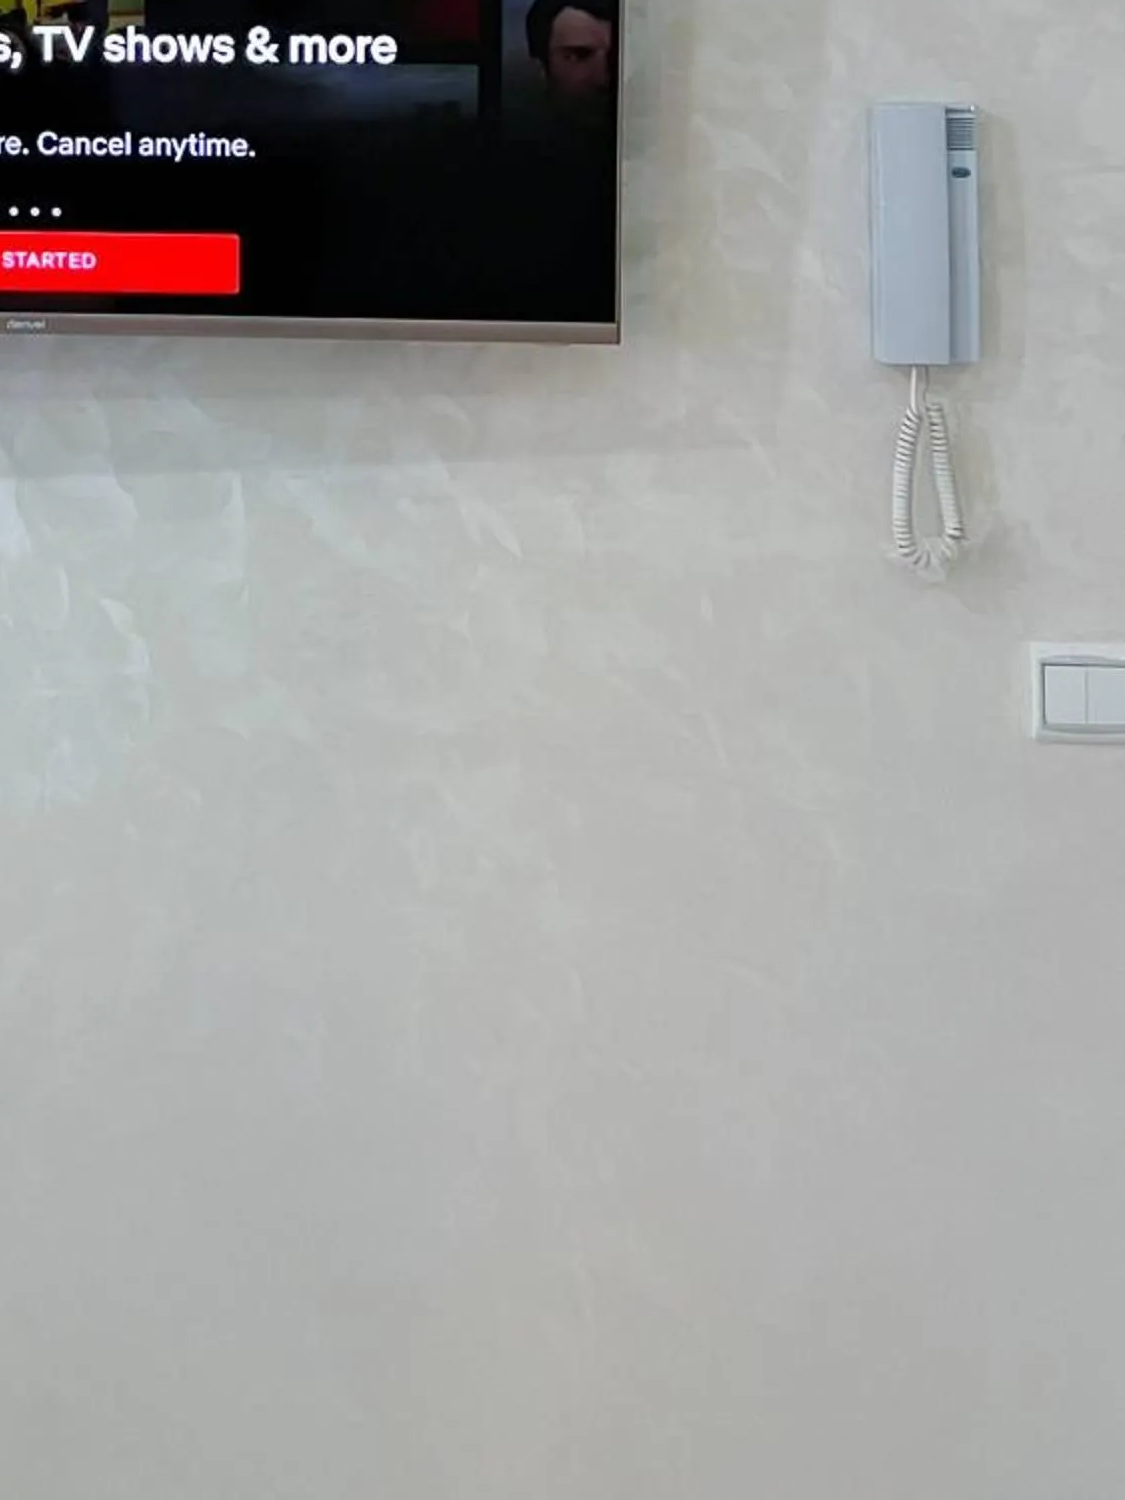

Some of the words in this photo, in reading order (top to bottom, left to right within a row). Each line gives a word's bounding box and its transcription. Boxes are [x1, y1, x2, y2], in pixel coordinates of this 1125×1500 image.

[32, 25, 95, 62] TV
[103, 25, 235, 64] shows
[245, 25, 280, 65] &
[288, 34, 398, 64] more
[37, 131, 132, 156] Cancel
[138, 133, 256, 162] anytime.
[2, 251, 97, 269] STARTED
